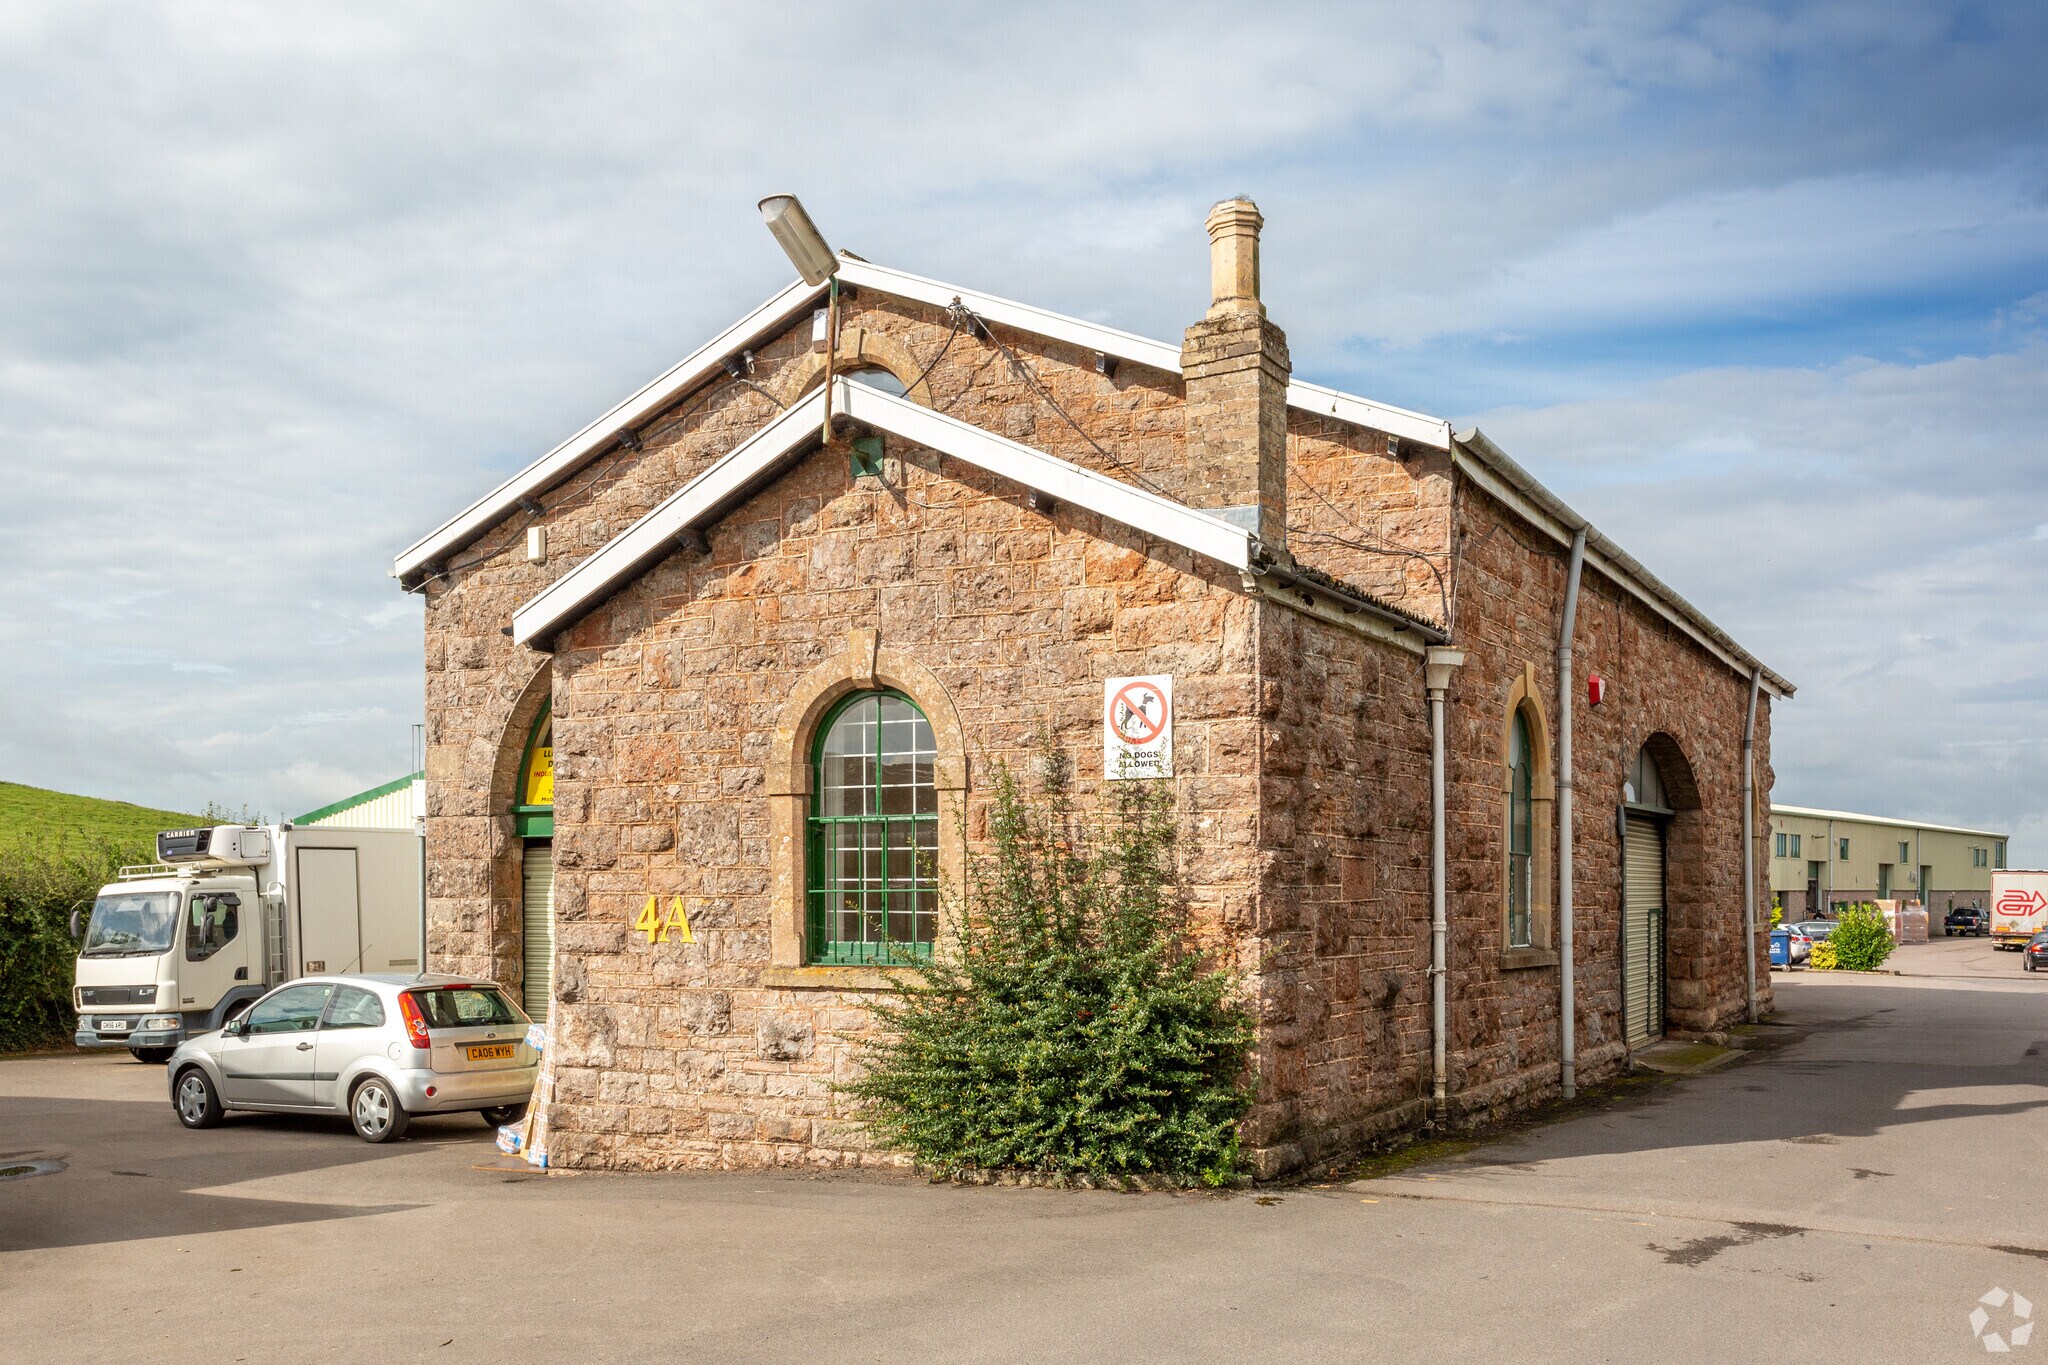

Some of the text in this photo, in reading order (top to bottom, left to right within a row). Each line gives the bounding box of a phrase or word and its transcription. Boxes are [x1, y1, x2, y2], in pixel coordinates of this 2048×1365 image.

[1134, 751, 1159, 759] DOGS
[166, 830, 195, 839] CARRIER
[635, 895, 697, 944] 4A
[472, 1046, 511, 1059] CA06 WYH
